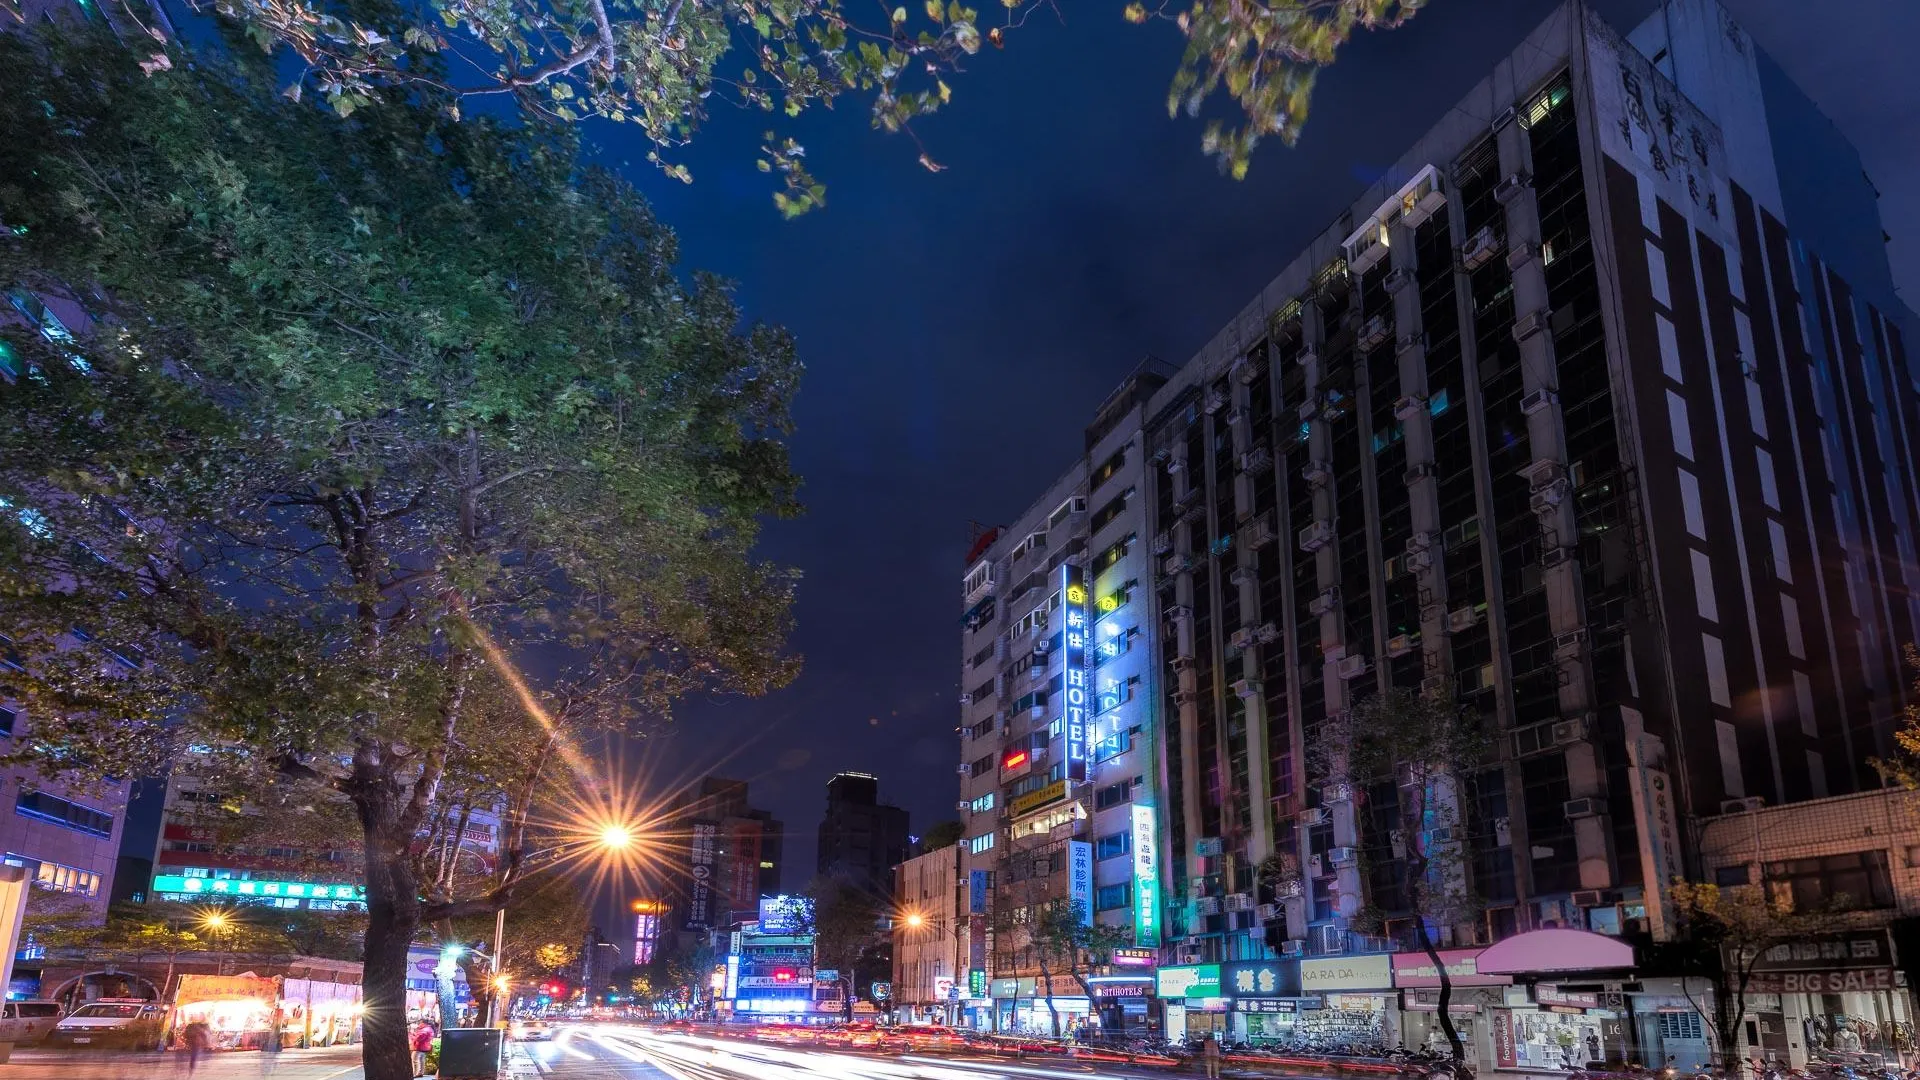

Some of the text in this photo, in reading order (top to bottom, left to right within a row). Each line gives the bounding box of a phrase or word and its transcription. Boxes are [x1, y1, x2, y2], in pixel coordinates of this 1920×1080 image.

[1068, 669, 1084, 760] HOTEL
[1075, 846, 1087, 892] 宏林診所
[1302, 971, 1318, 981] KA
[1320, 969, 1335, 980] RA
[1338, 968, 1354, 979] DA
[1784, 973, 1822, 991] BIG
[1828, 969, 1890, 991] SALE
[1102, 987, 1142, 997] SITIHOTELS
[1500, 1015, 1511, 1061] mamaway
[1609, 1024, 1621, 1035] 16
